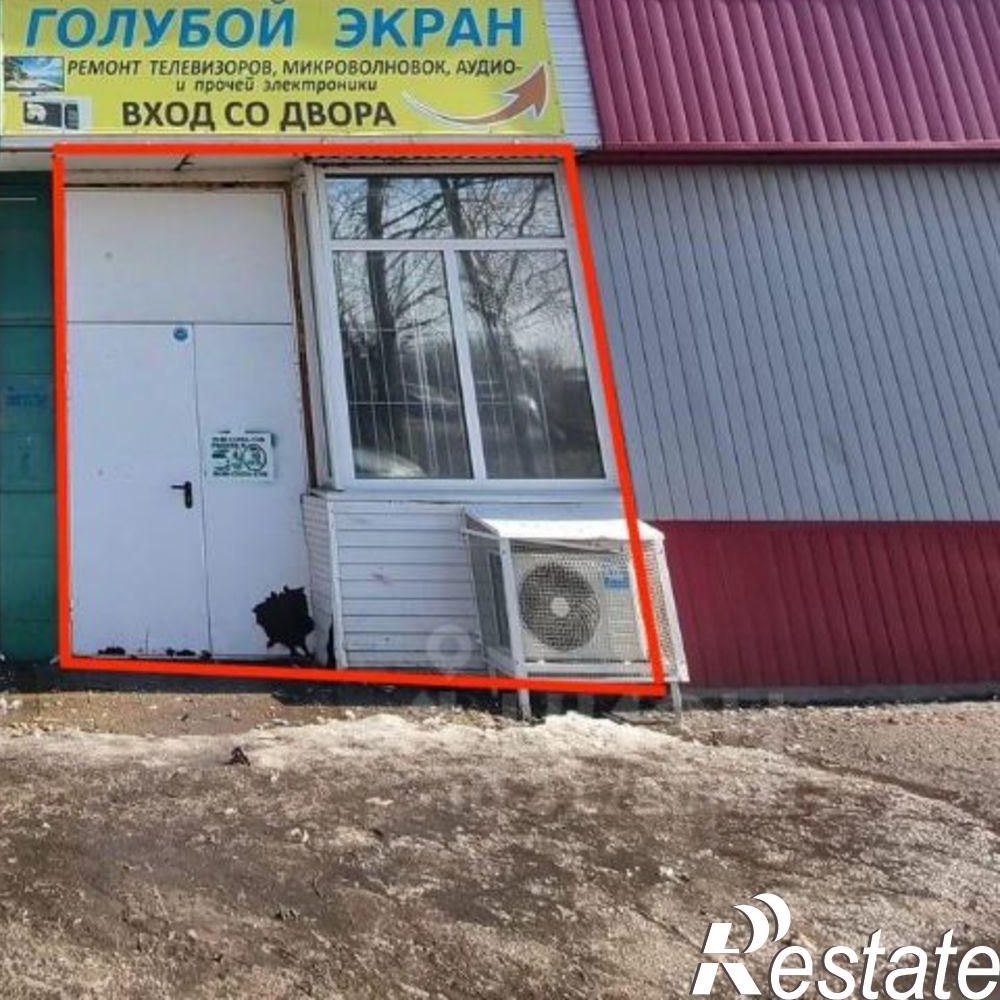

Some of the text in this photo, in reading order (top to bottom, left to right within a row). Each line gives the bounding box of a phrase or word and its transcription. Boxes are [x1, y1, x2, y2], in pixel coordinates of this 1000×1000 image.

[334, 7, 522, 48] ЭКРАН
[67, 60, 522, 77] РЕМОНТ ТЕЛЕВИЗОРОВ, МИКРОВОЛНОВОК, АУДИО-
[176, 78, 378, 94] и прочей электроники
[122, 101, 397, 131] ВХОД СО ДВОРА
